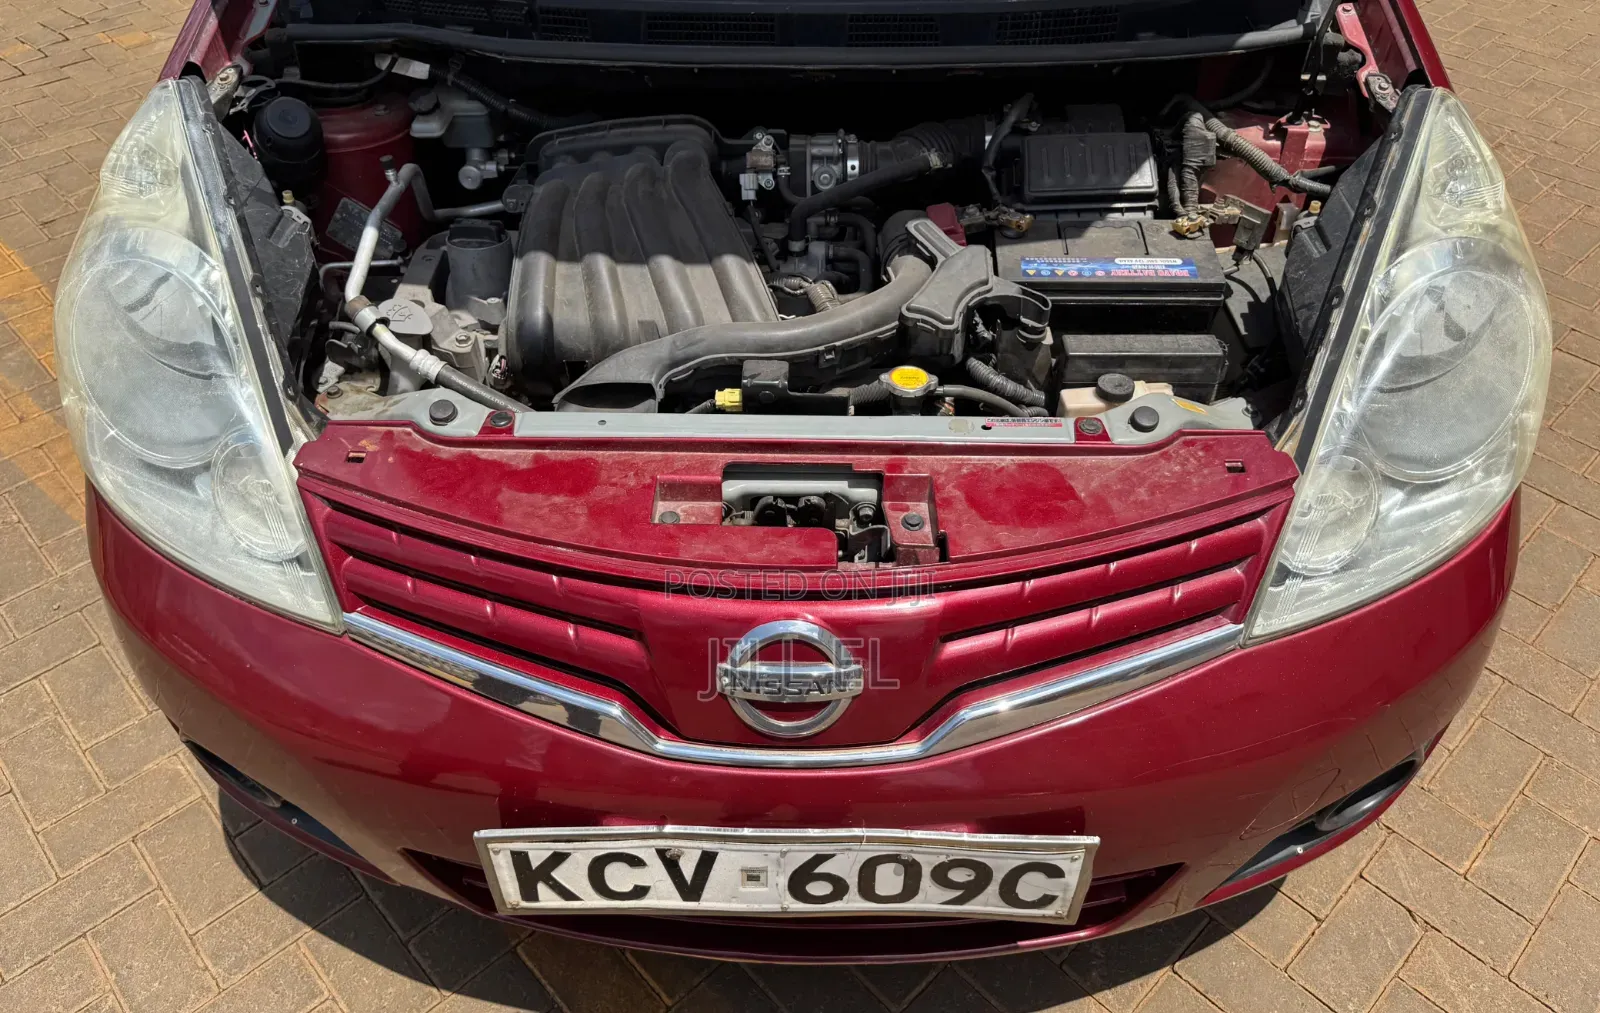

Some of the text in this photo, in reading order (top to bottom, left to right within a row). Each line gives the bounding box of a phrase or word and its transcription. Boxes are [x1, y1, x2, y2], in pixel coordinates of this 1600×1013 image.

[1111, 269, 1156, 277] BATTERY
[731, 676, 848, 696] NISSAN
[511, 848, 1066, 910] KCV 609C
